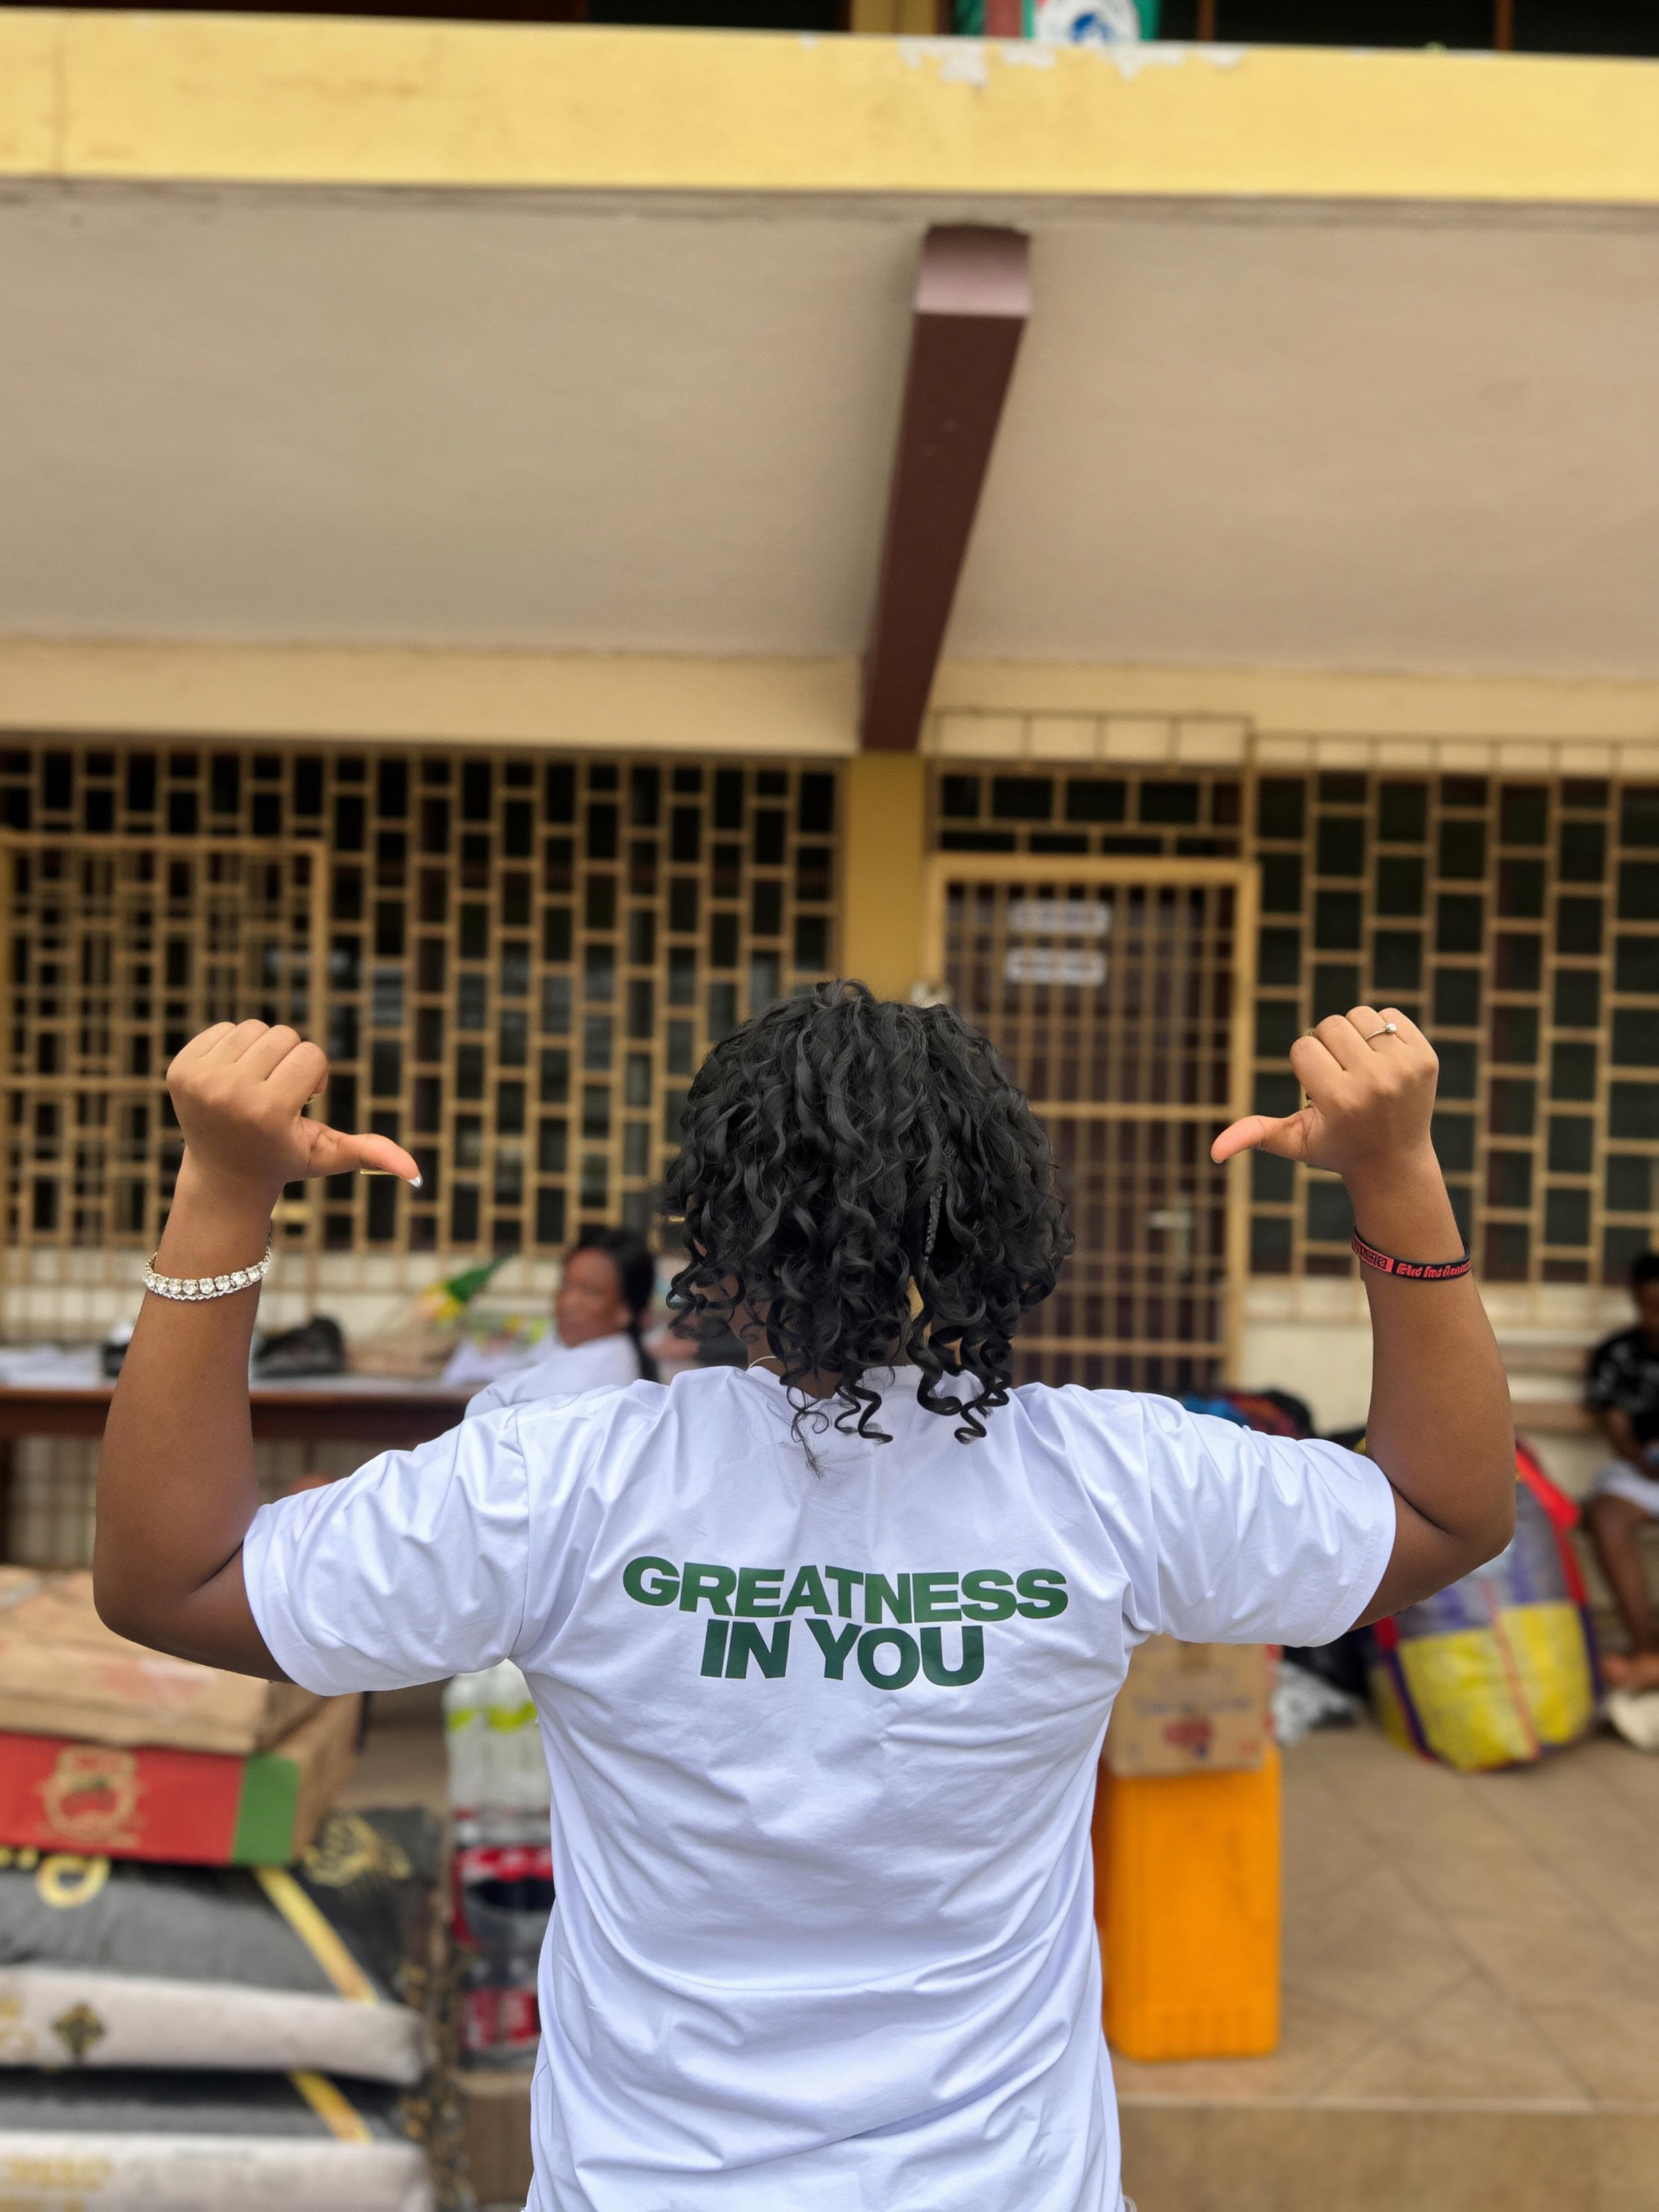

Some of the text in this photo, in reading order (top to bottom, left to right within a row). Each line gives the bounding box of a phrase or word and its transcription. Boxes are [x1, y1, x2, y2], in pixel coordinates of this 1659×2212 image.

[623, 1556, 1069, 1624] GREATNESS
[700, 1618, 985, 1690] IN YOU
